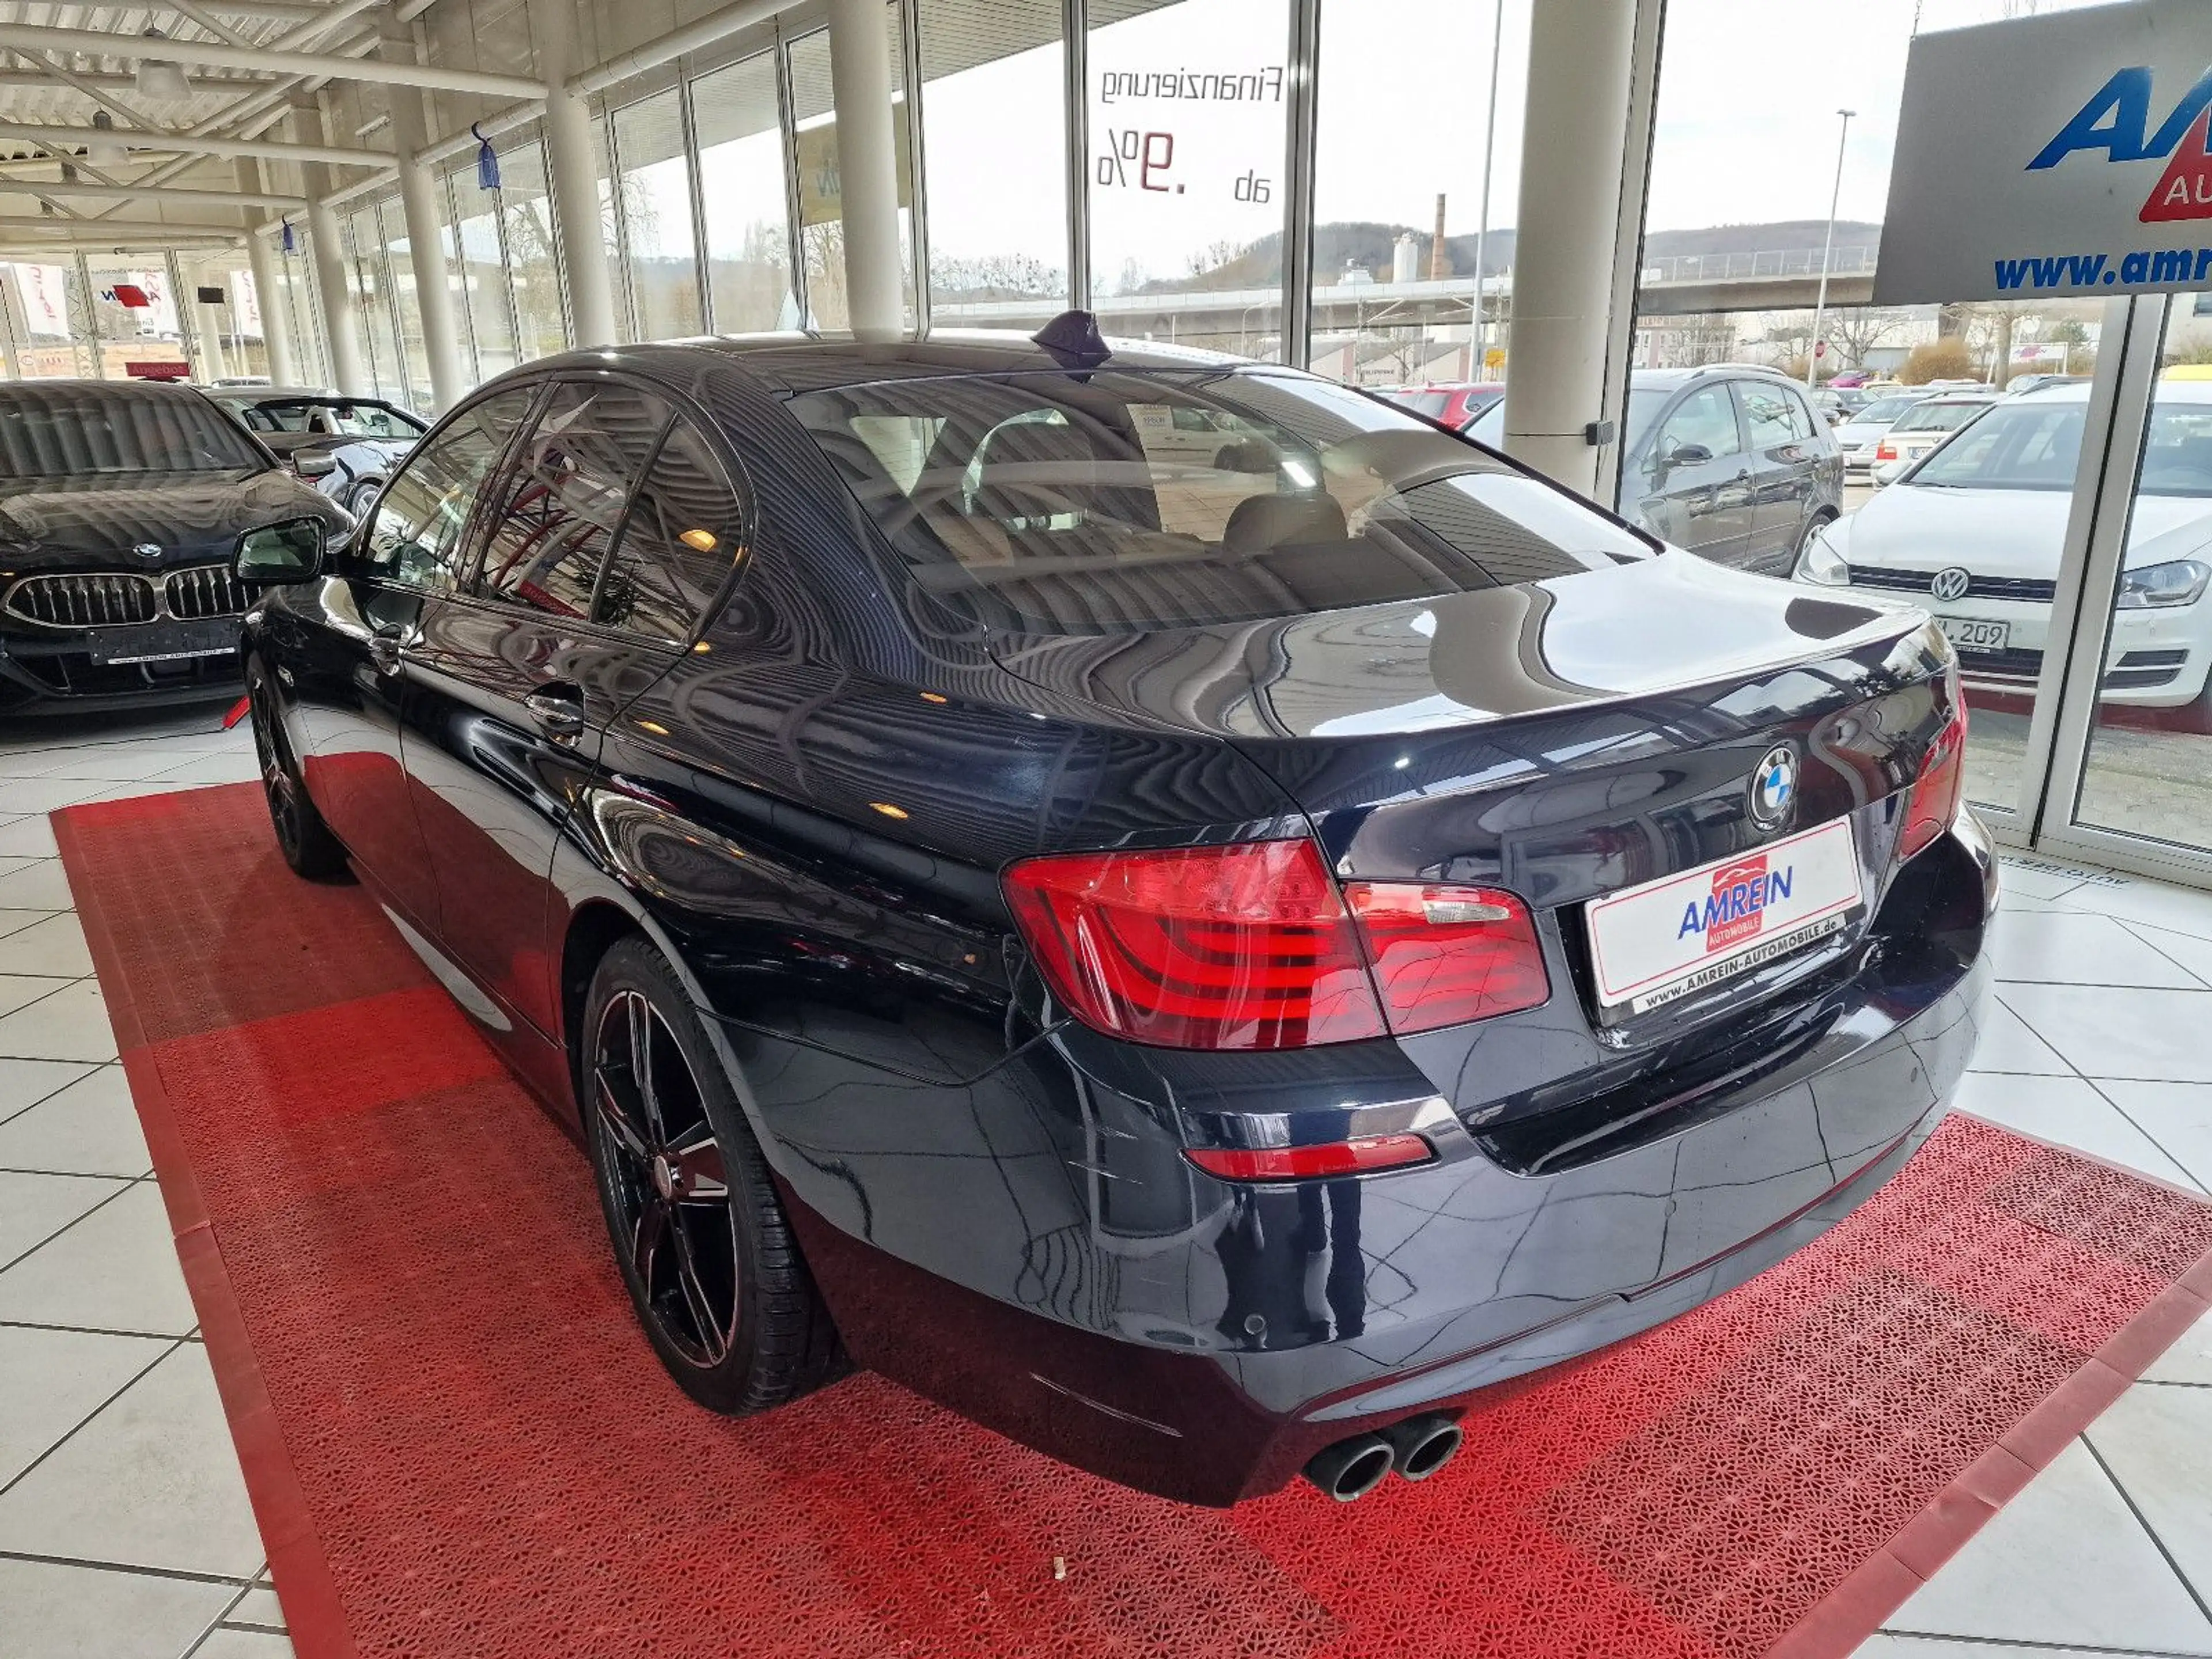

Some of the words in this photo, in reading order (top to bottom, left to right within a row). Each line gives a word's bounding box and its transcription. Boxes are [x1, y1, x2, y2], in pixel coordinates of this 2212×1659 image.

[1960, 623, 2003, 645] 209
[1677, 866, 1792, 940] AMREIN
[1709, 917, 1760, 946] AUTOMOBILE
[1646, 919, 1837, 1007] www.AMREIN-AUTOMOBILE.de
